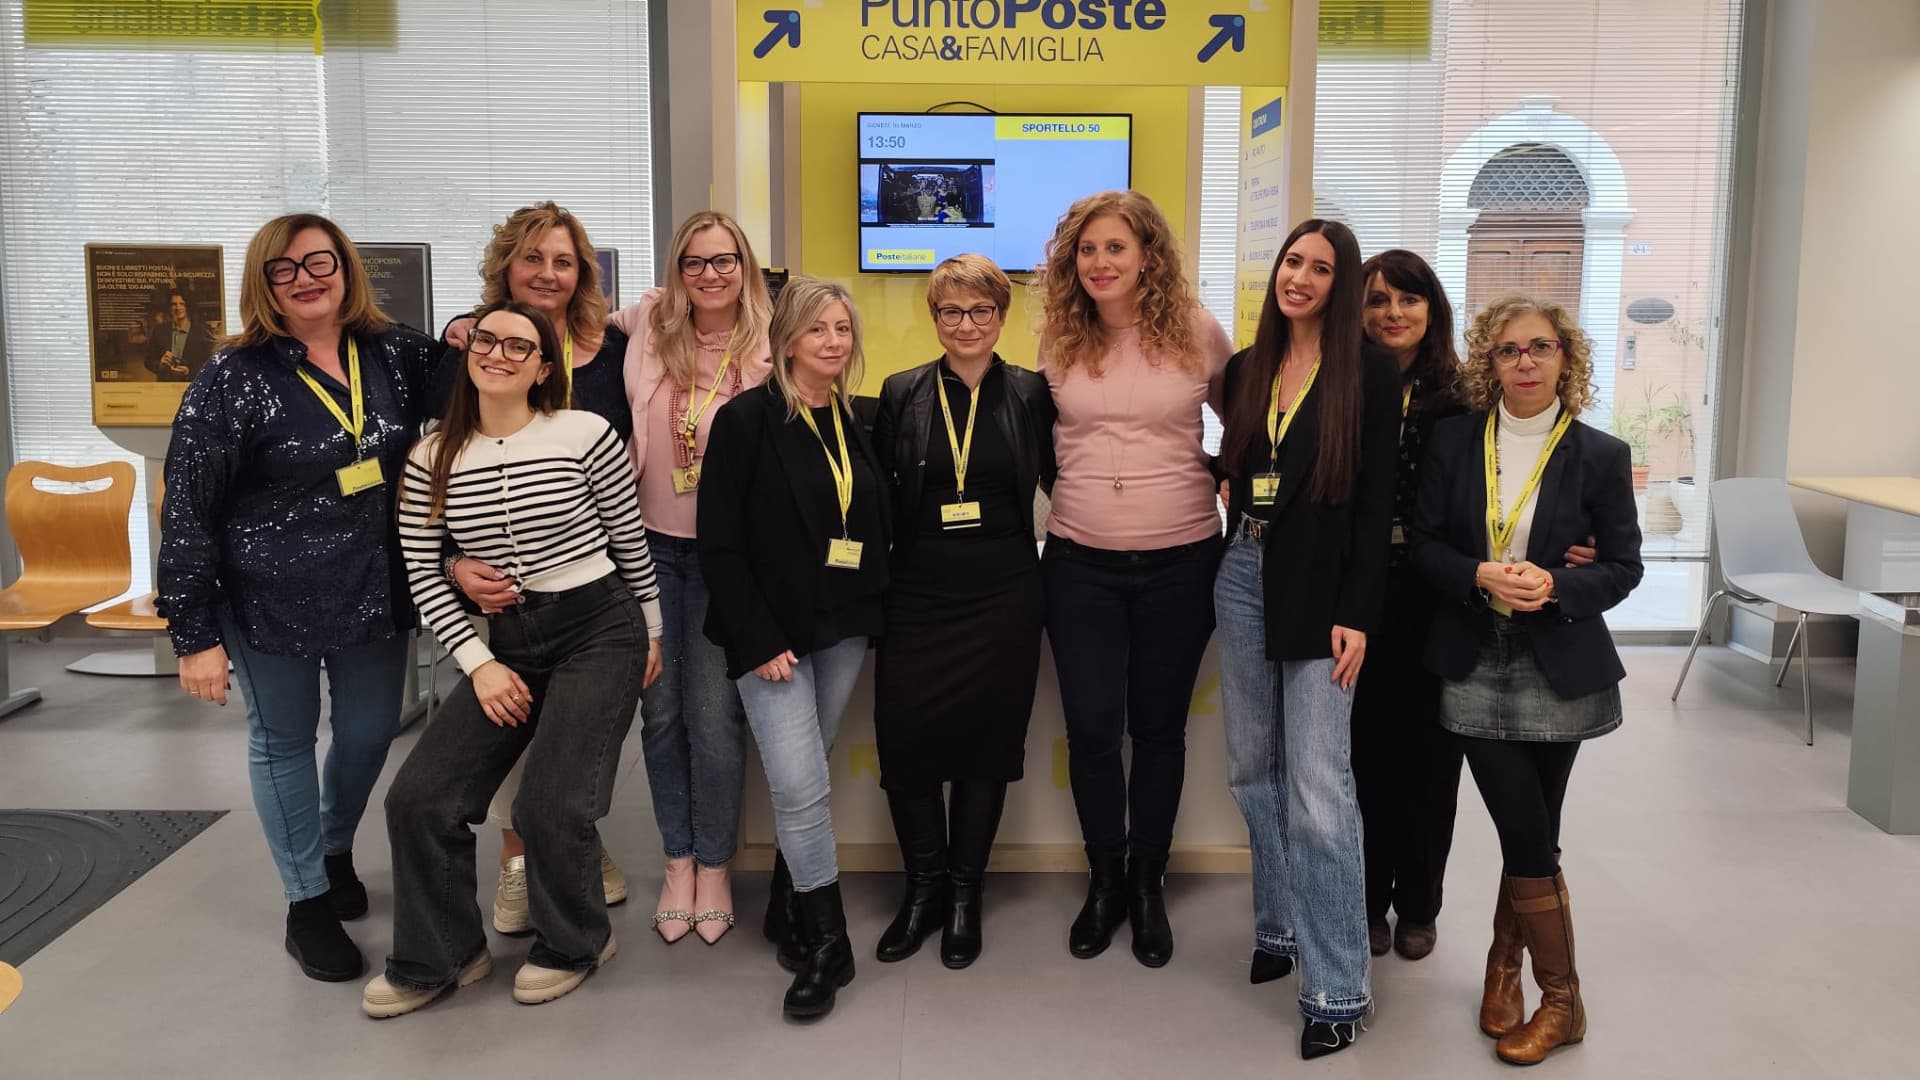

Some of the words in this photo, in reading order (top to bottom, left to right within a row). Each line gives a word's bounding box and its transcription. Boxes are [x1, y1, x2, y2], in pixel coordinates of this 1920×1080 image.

[860, 0, 1167, 30] PuntoPoste
[861, 34, 1105, 62] CASA&FAMIGLIA
[1022, 123, 1085, 133] SPORTELLO
[1087, 123, 1101, 133] 50
[868, 135, 906, 149] 13:50
[876, 251, 927, 261] Posteitaliane
